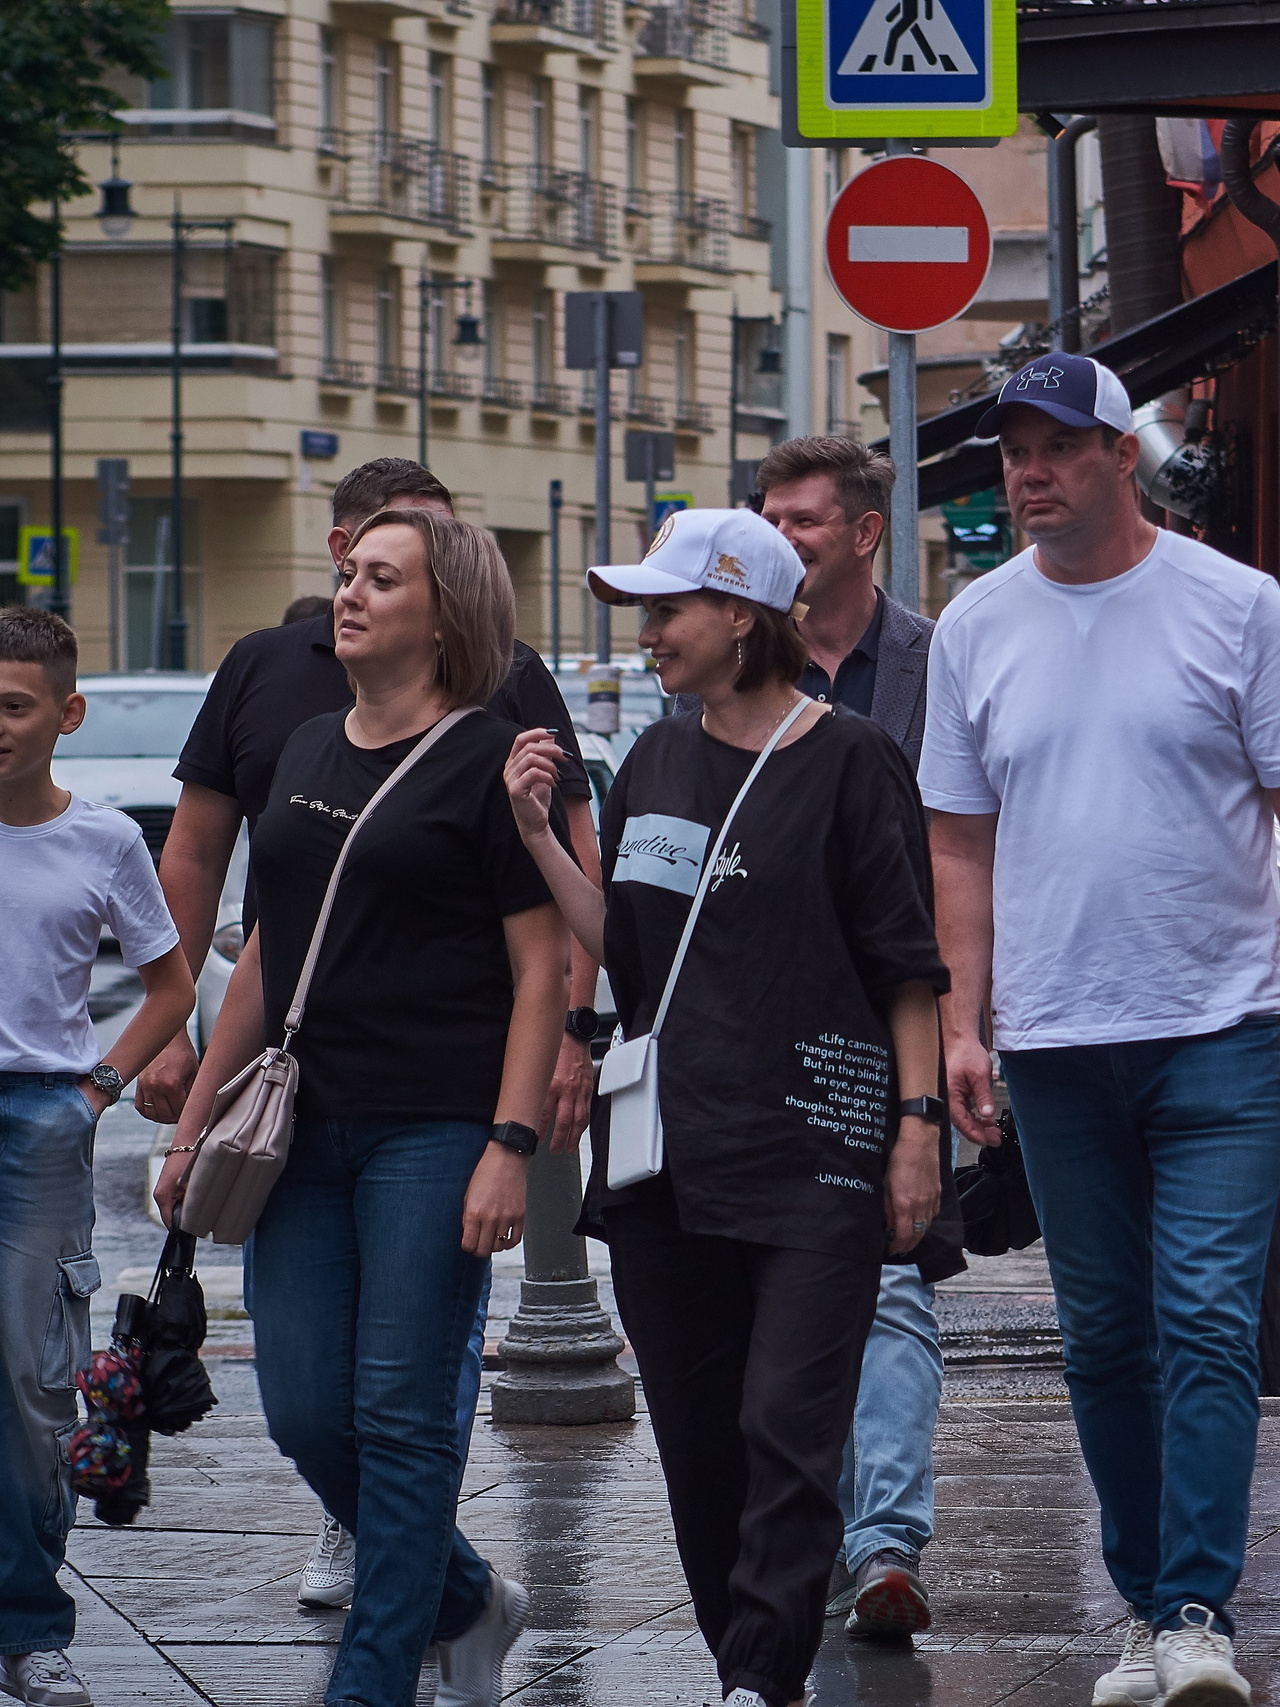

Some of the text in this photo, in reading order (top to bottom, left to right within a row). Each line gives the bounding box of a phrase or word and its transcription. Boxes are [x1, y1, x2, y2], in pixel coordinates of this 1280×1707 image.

[707, 572, 751, 591] BURBERRY
[794, 1041, 843, 1060] changed
[803, 1056, 822, 1070] But
[824, 1061, 835, 1073] in
[838, 1064, 856, 1077] the
[857, 1067, 881, 1083] blink
[813, 1075, 827, 1086] an
[829, 1079, 851, 1092] eye,
[853, 1084, 873, 1095] you
[785, 1095, 837, 1117] thoughts,
[840, 1108, 872, 1122] which
[828, 1092, 867, 1108] change
[806, 1115, 847, 1133] change
[849, 1124, 872, 1136] your
